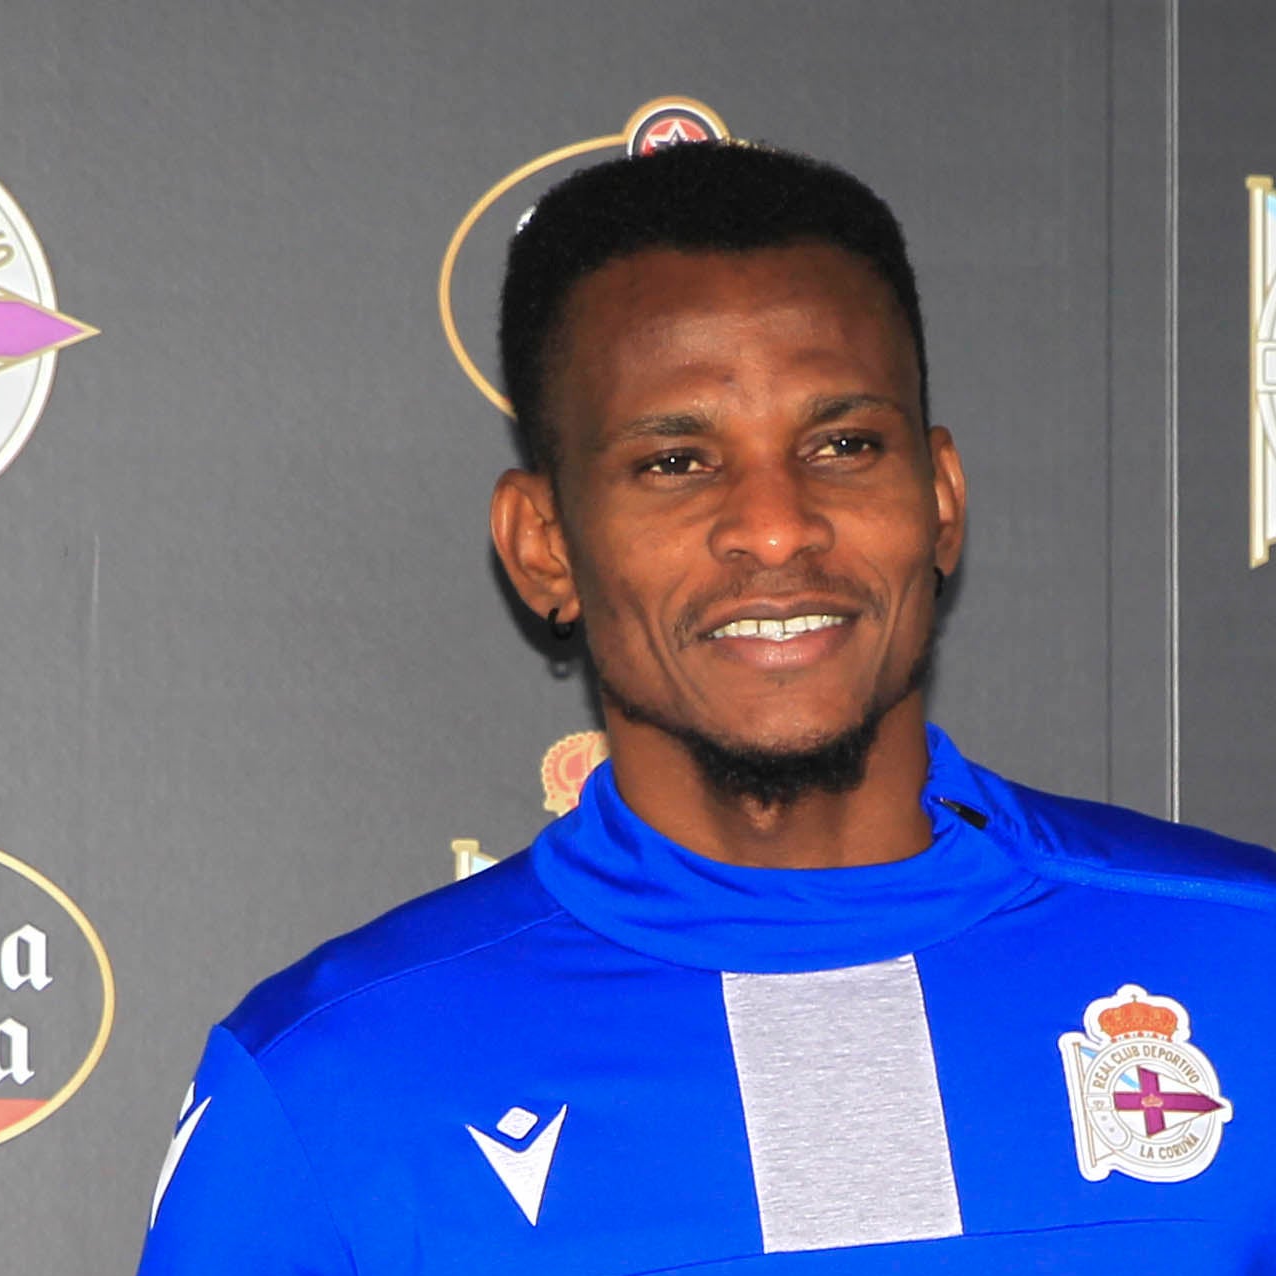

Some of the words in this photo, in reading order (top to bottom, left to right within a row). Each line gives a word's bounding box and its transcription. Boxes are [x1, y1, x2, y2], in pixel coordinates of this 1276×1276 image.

[1093, 1062, 1115, 1089] REAL
[1111, 1045, 1140, 1065] CLUB
[1143, 1045, 1200, 1084] DEPORTIVO
[1140, 1144, 1154, 1159] LA
